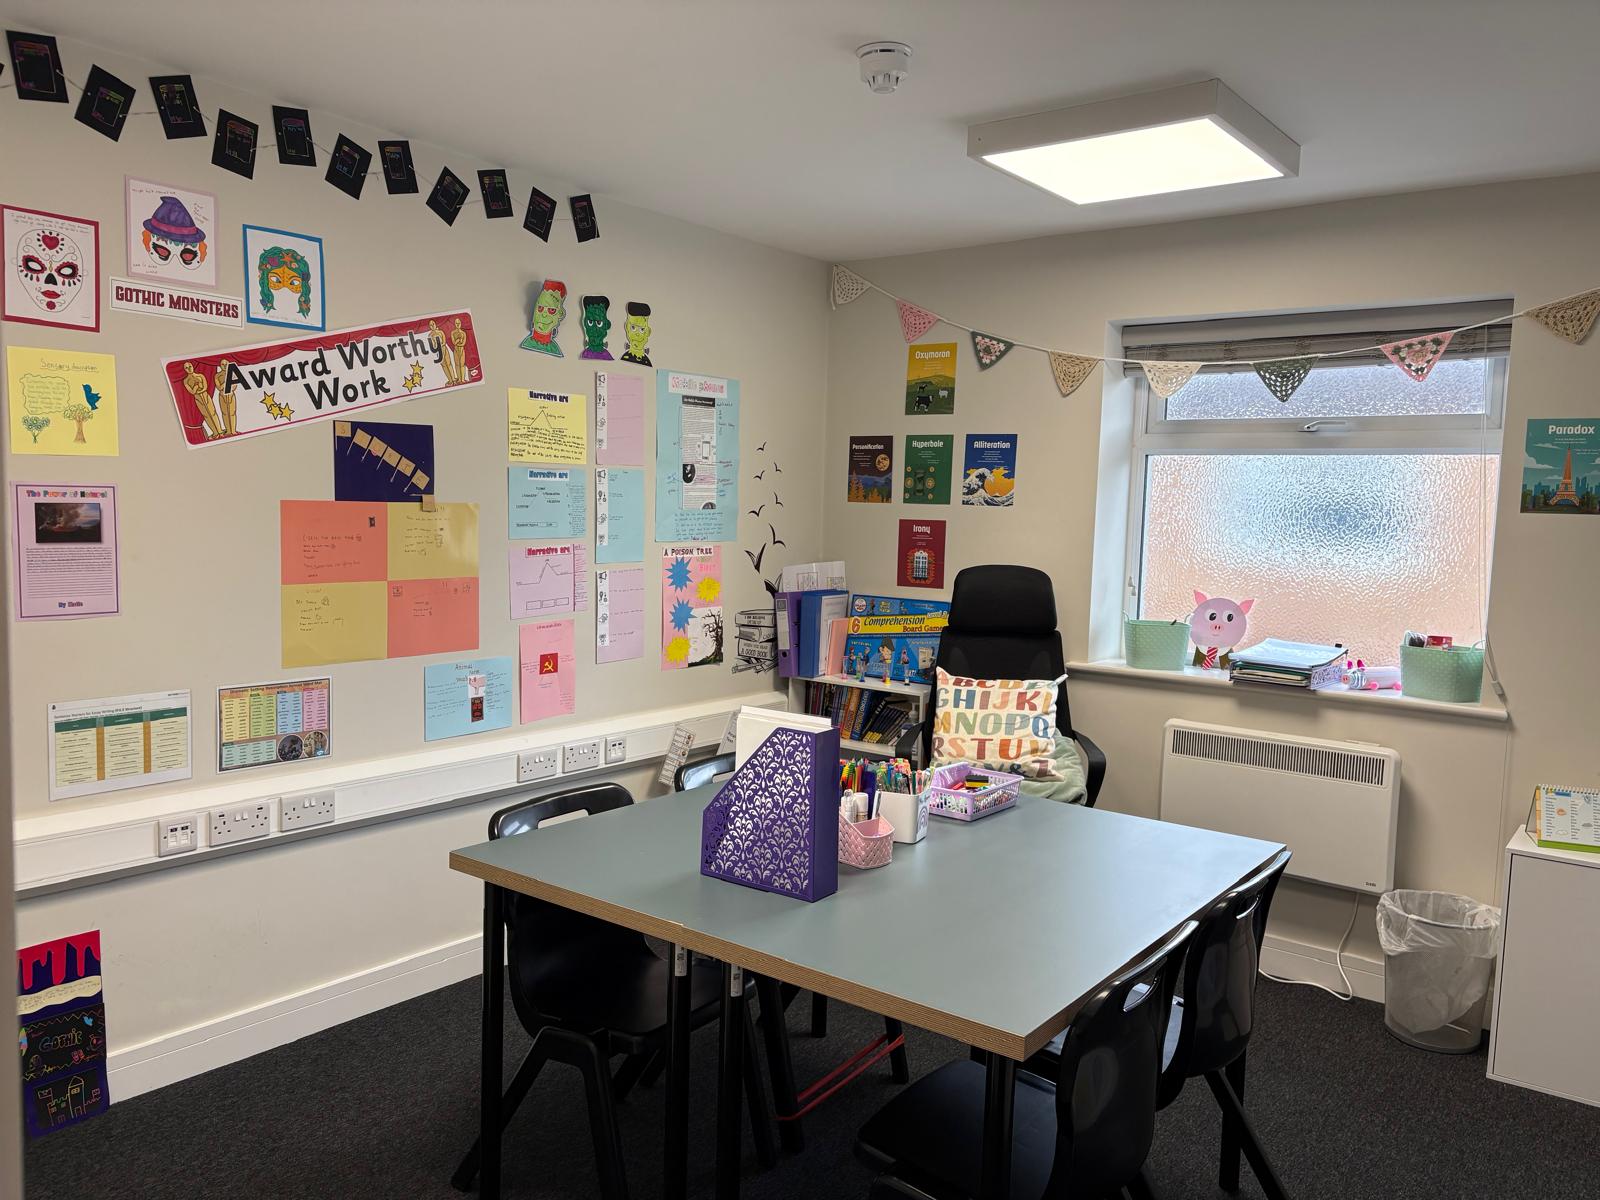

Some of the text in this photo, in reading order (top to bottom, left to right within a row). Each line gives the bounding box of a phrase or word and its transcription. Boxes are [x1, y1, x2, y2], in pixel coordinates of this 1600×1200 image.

[115, 286, 240, 319] GOTHIC MONSTERS
[915, 350, 950, 360] Oxymoron
[223, 331, 444, 394] Award Worthy
[303, 369, 391, 411] Work
[529, 390, 569, 403] Narrative arc
[1548, 424, 1596, 435] Paradox
[912, 440, 944, 449] Hyperbole
[974, 440, 1011, 449] Alliteration
[528, 470, 568, 479] Narrative arc
[26, 490, 41, 498] The
[43, 490, 67, 498] Power
[913, 524, 931, 534] Irony
[527, 546, 570, 556] Narrative arc
[664, 547, 713, 557] A POISON TREE
[851, 616, 861, 634] 6
[864, 616, 925, 627] Comprehension
[902, 625, 923, 633] Board
